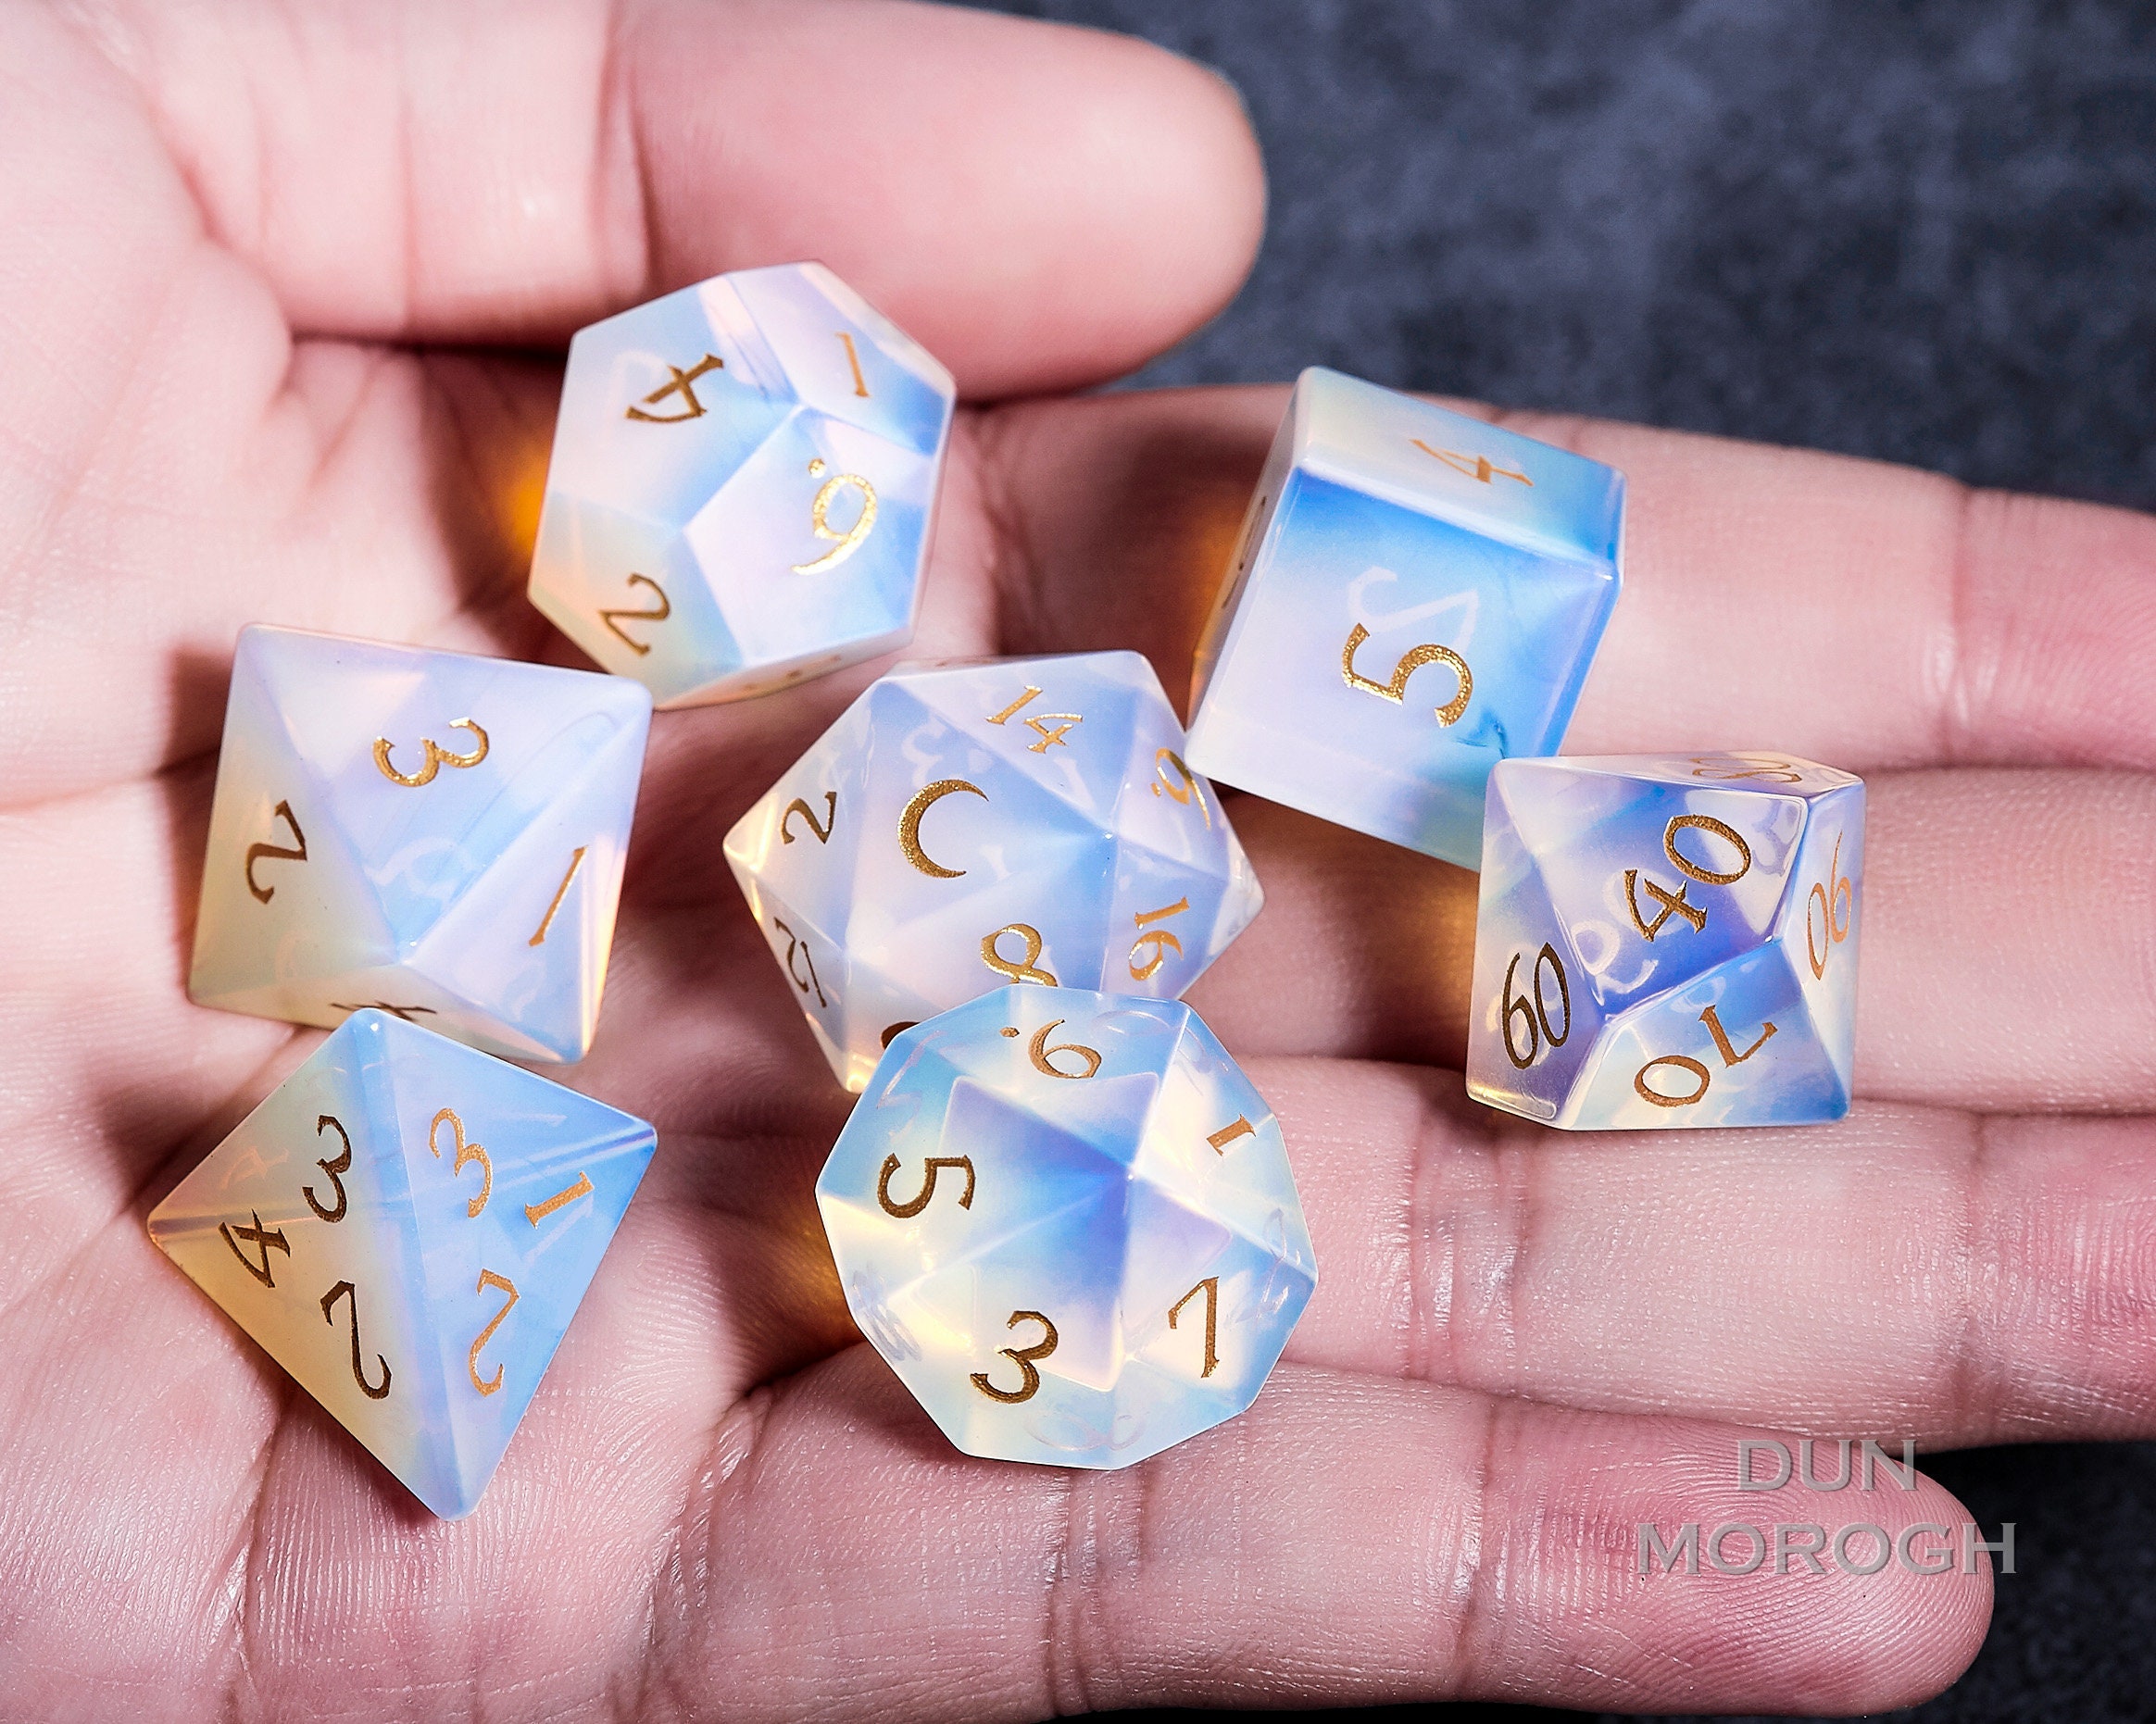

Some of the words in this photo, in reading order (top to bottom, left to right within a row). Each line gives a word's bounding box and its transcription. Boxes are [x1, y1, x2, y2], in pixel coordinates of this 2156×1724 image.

[836, 331, 871, 397] 1
[1408, 430, 1536, 487] 4
[598, 572, 671, 657] 2
[985, 685, 1084, 755] 14
[1341, 622, 1473, 729] 5
[374, 717, 490, 787] 3
[244, 800, 307, 905] 2
[781, 791, 837, 844] 2
[529, 846, 588, 947] 1
[1623, 814, 1751, 943] 40
[1128, 897, 1191, 981] 16
[1501, 942, 1571, 1070] 60
[302, 1115, 352, 1222] 3
[429, 1108, 493, 1218] 3
[1206, 1114, 1257, 1156] 1
[525, 1171, 595, 1230] 1
[877, 1153, 976, 1219] 5
[219, 1209, 291, 1289] 4
[320, 1280, 392, 1400] 2
[469, 1268, 520, 1398] 2
[970, 1310, 1059, 1404] 3
[1168, 1276, 1220, 1379] 7
